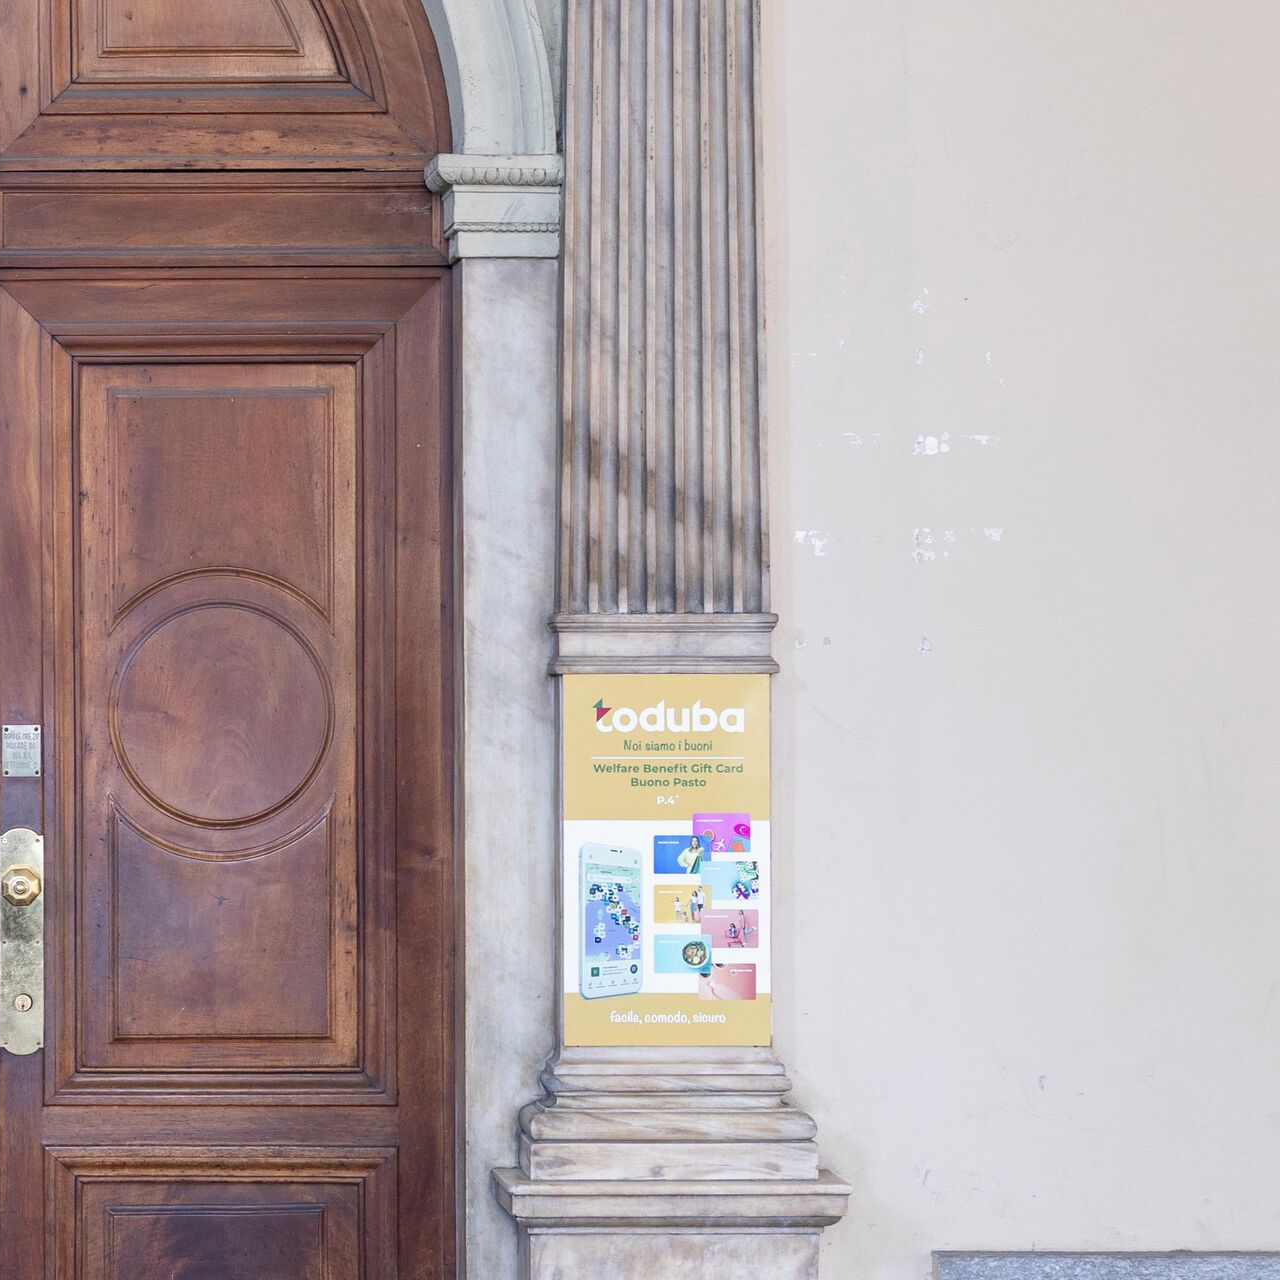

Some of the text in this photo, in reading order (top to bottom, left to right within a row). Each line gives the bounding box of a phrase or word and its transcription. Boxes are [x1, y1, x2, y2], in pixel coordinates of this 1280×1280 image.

[592, 698, 745, 733] toduba
[624, 739, 713, 751] Noi siamo i buoni
[593, 763, 744, 773] Welfare Benefit Gift Card
[630, 777, 707, 787] Buono Pasto
[609, 1010, 727, 1024] facile, comodo, sicuro
